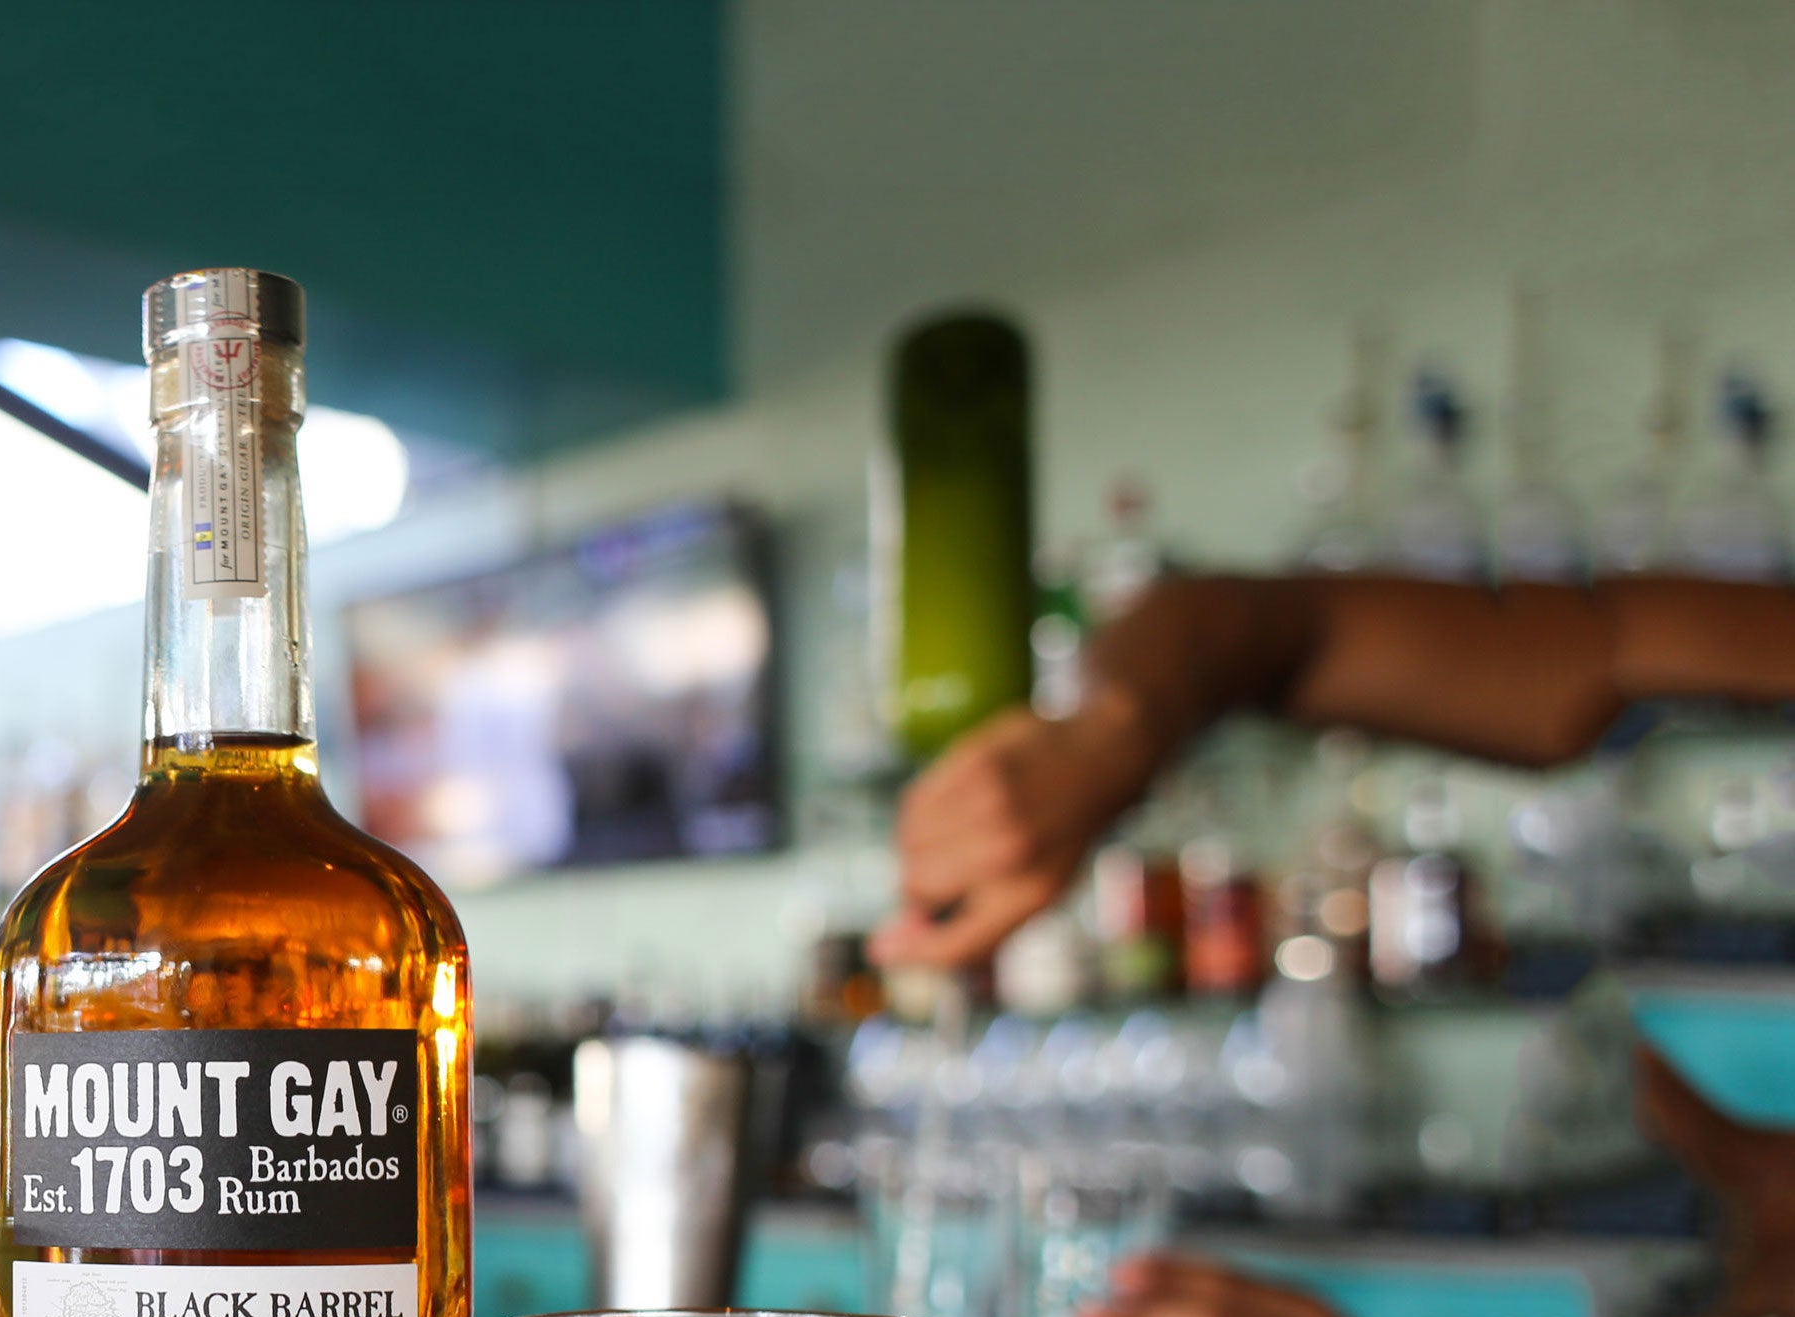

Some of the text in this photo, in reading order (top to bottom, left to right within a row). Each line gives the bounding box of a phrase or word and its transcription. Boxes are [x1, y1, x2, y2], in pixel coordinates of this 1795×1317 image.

[219, 464, 228, 491] GAY
[220, 497, 229, 550] MOUNT
[239, 487, 251, 540] ORIGIN
[25, 1061, 398, 1138] MOUNT GAY
[22, 1145, 203, 1214] Est. 1703
[249, 1143, 399, 1182] Barbados
[218, 1177, 301, 1215] Rum
